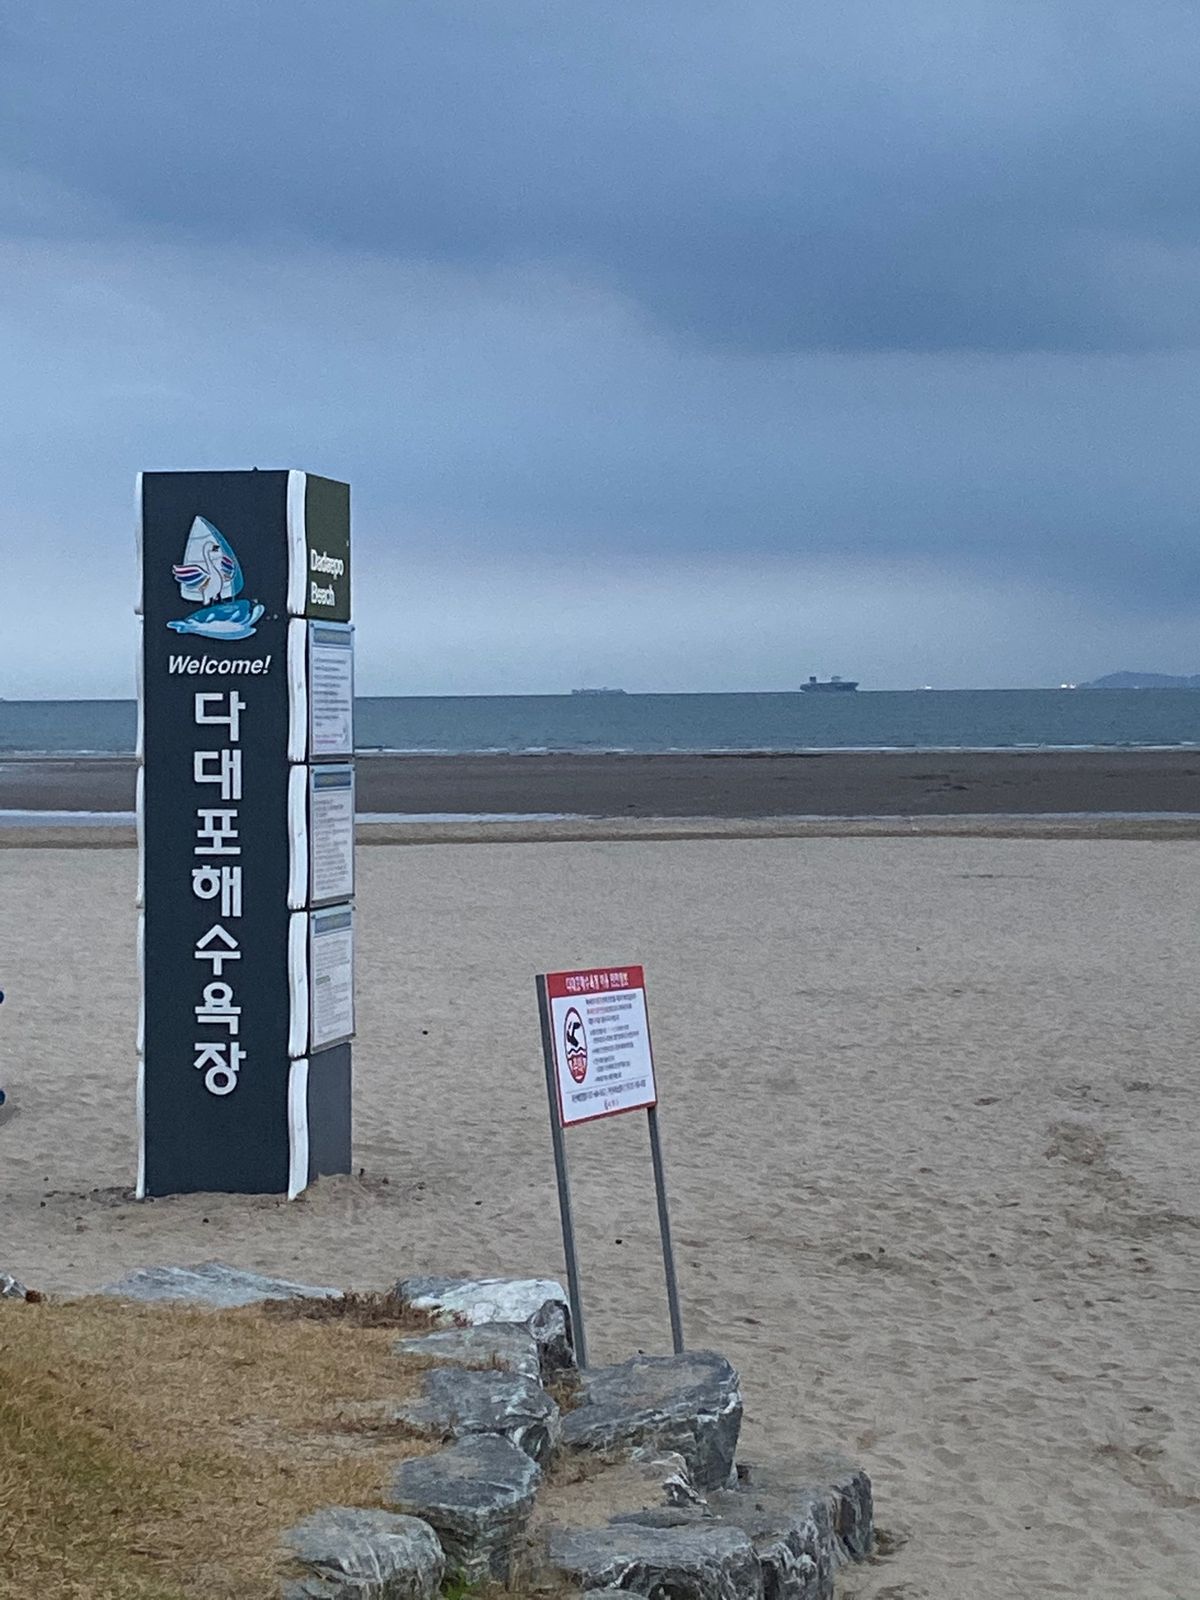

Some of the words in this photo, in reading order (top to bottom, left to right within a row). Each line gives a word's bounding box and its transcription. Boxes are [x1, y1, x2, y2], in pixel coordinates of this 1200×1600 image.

[310, 581, 335, 606] Beach
[168, 655, 272, 675] Welcome!
[192, 691, 247, 1096] 다대포해수욕장
